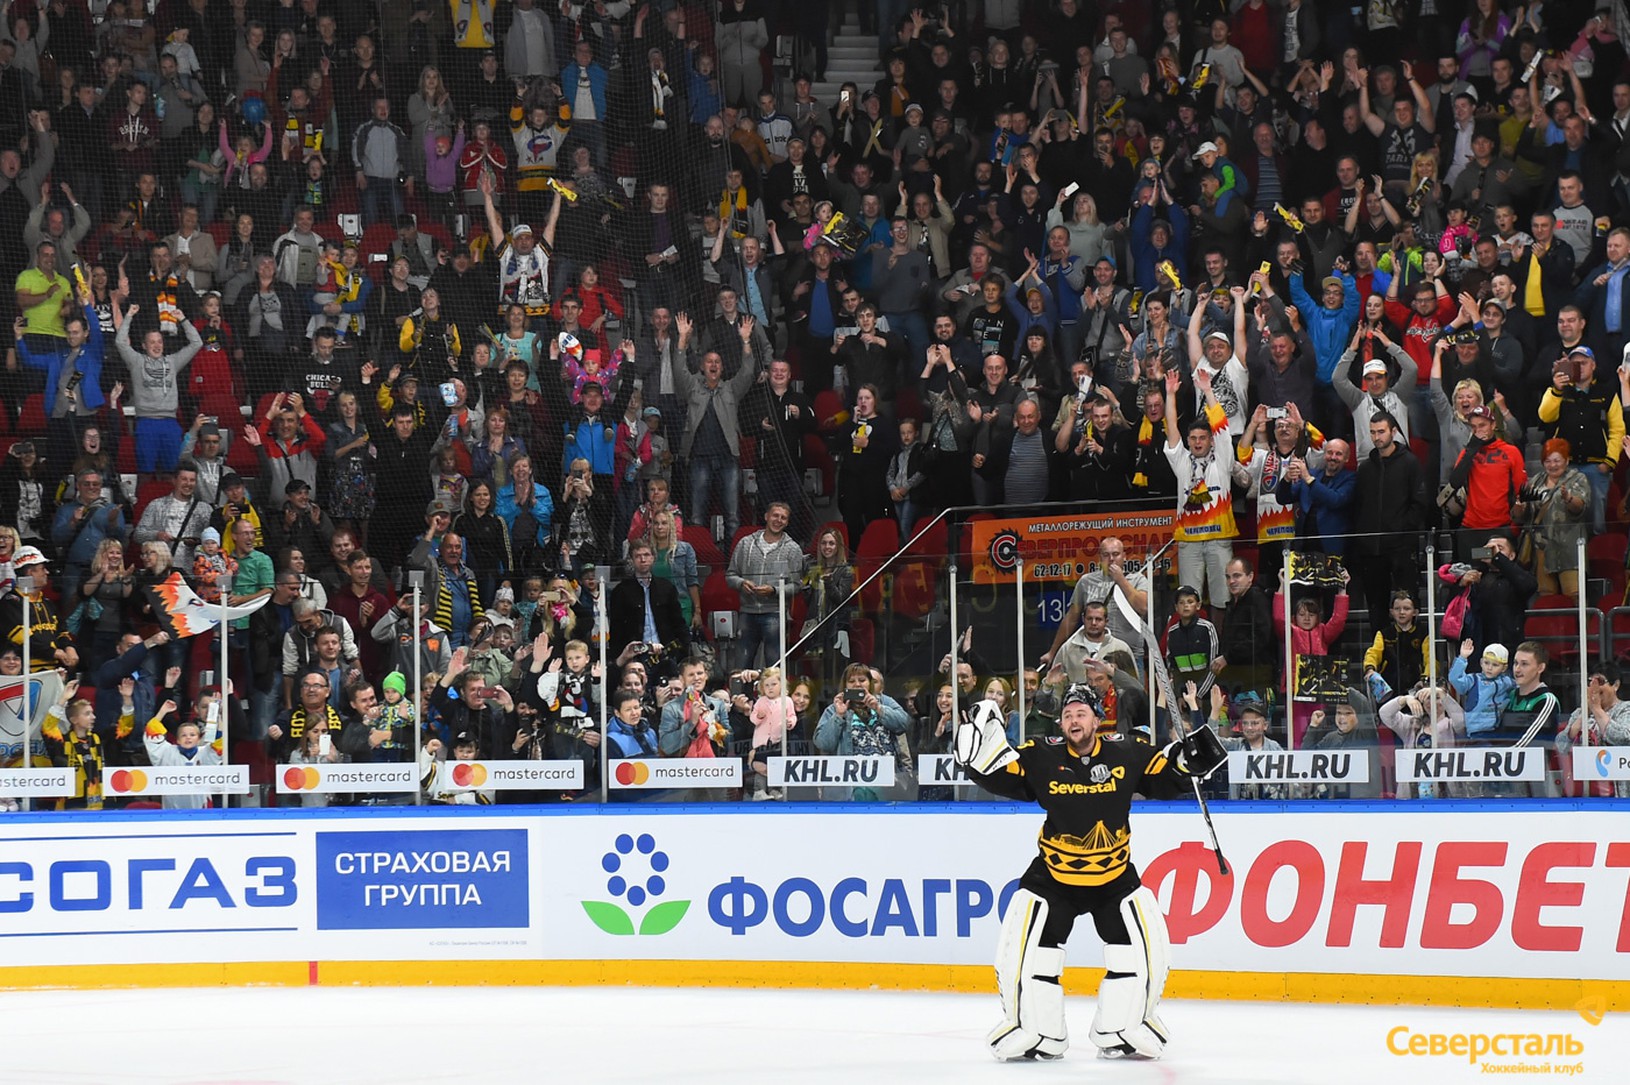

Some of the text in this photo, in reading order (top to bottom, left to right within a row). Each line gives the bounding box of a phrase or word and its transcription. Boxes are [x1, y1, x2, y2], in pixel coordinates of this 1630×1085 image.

[305, 374, 342, 383] CHICAO
[1028, 516, 1172, 533] МЕТАЛЛОРЕЖУЩИЙ ИНСТРУМЕНТ
[992, 533, 1174, 568] СЕВЕРПРОСНАБ
[1034, 563, 1071, 577] 62-12-17
[494, 767, 575, 780] mastercard
[655, 765, 734, 778] mastercard
[784, 759, 879, 783] KHL.RU
[1246, 754, 1351, 779] KHL.RU
[1414, 752, 1526, 778] KHL.RU
[0, 775, 67, 788] stercard
[155, 772, 240, 785] mastercard
[327, 770, 411, 783] mastercard
[1049, 778, 1117, 795] Severstal
[335, 850, 511, 875] СТРАХОВАЯ
[0, 856, 298, 914] СОГАЗ
[364, 884, 482, 907] ГРУППА
